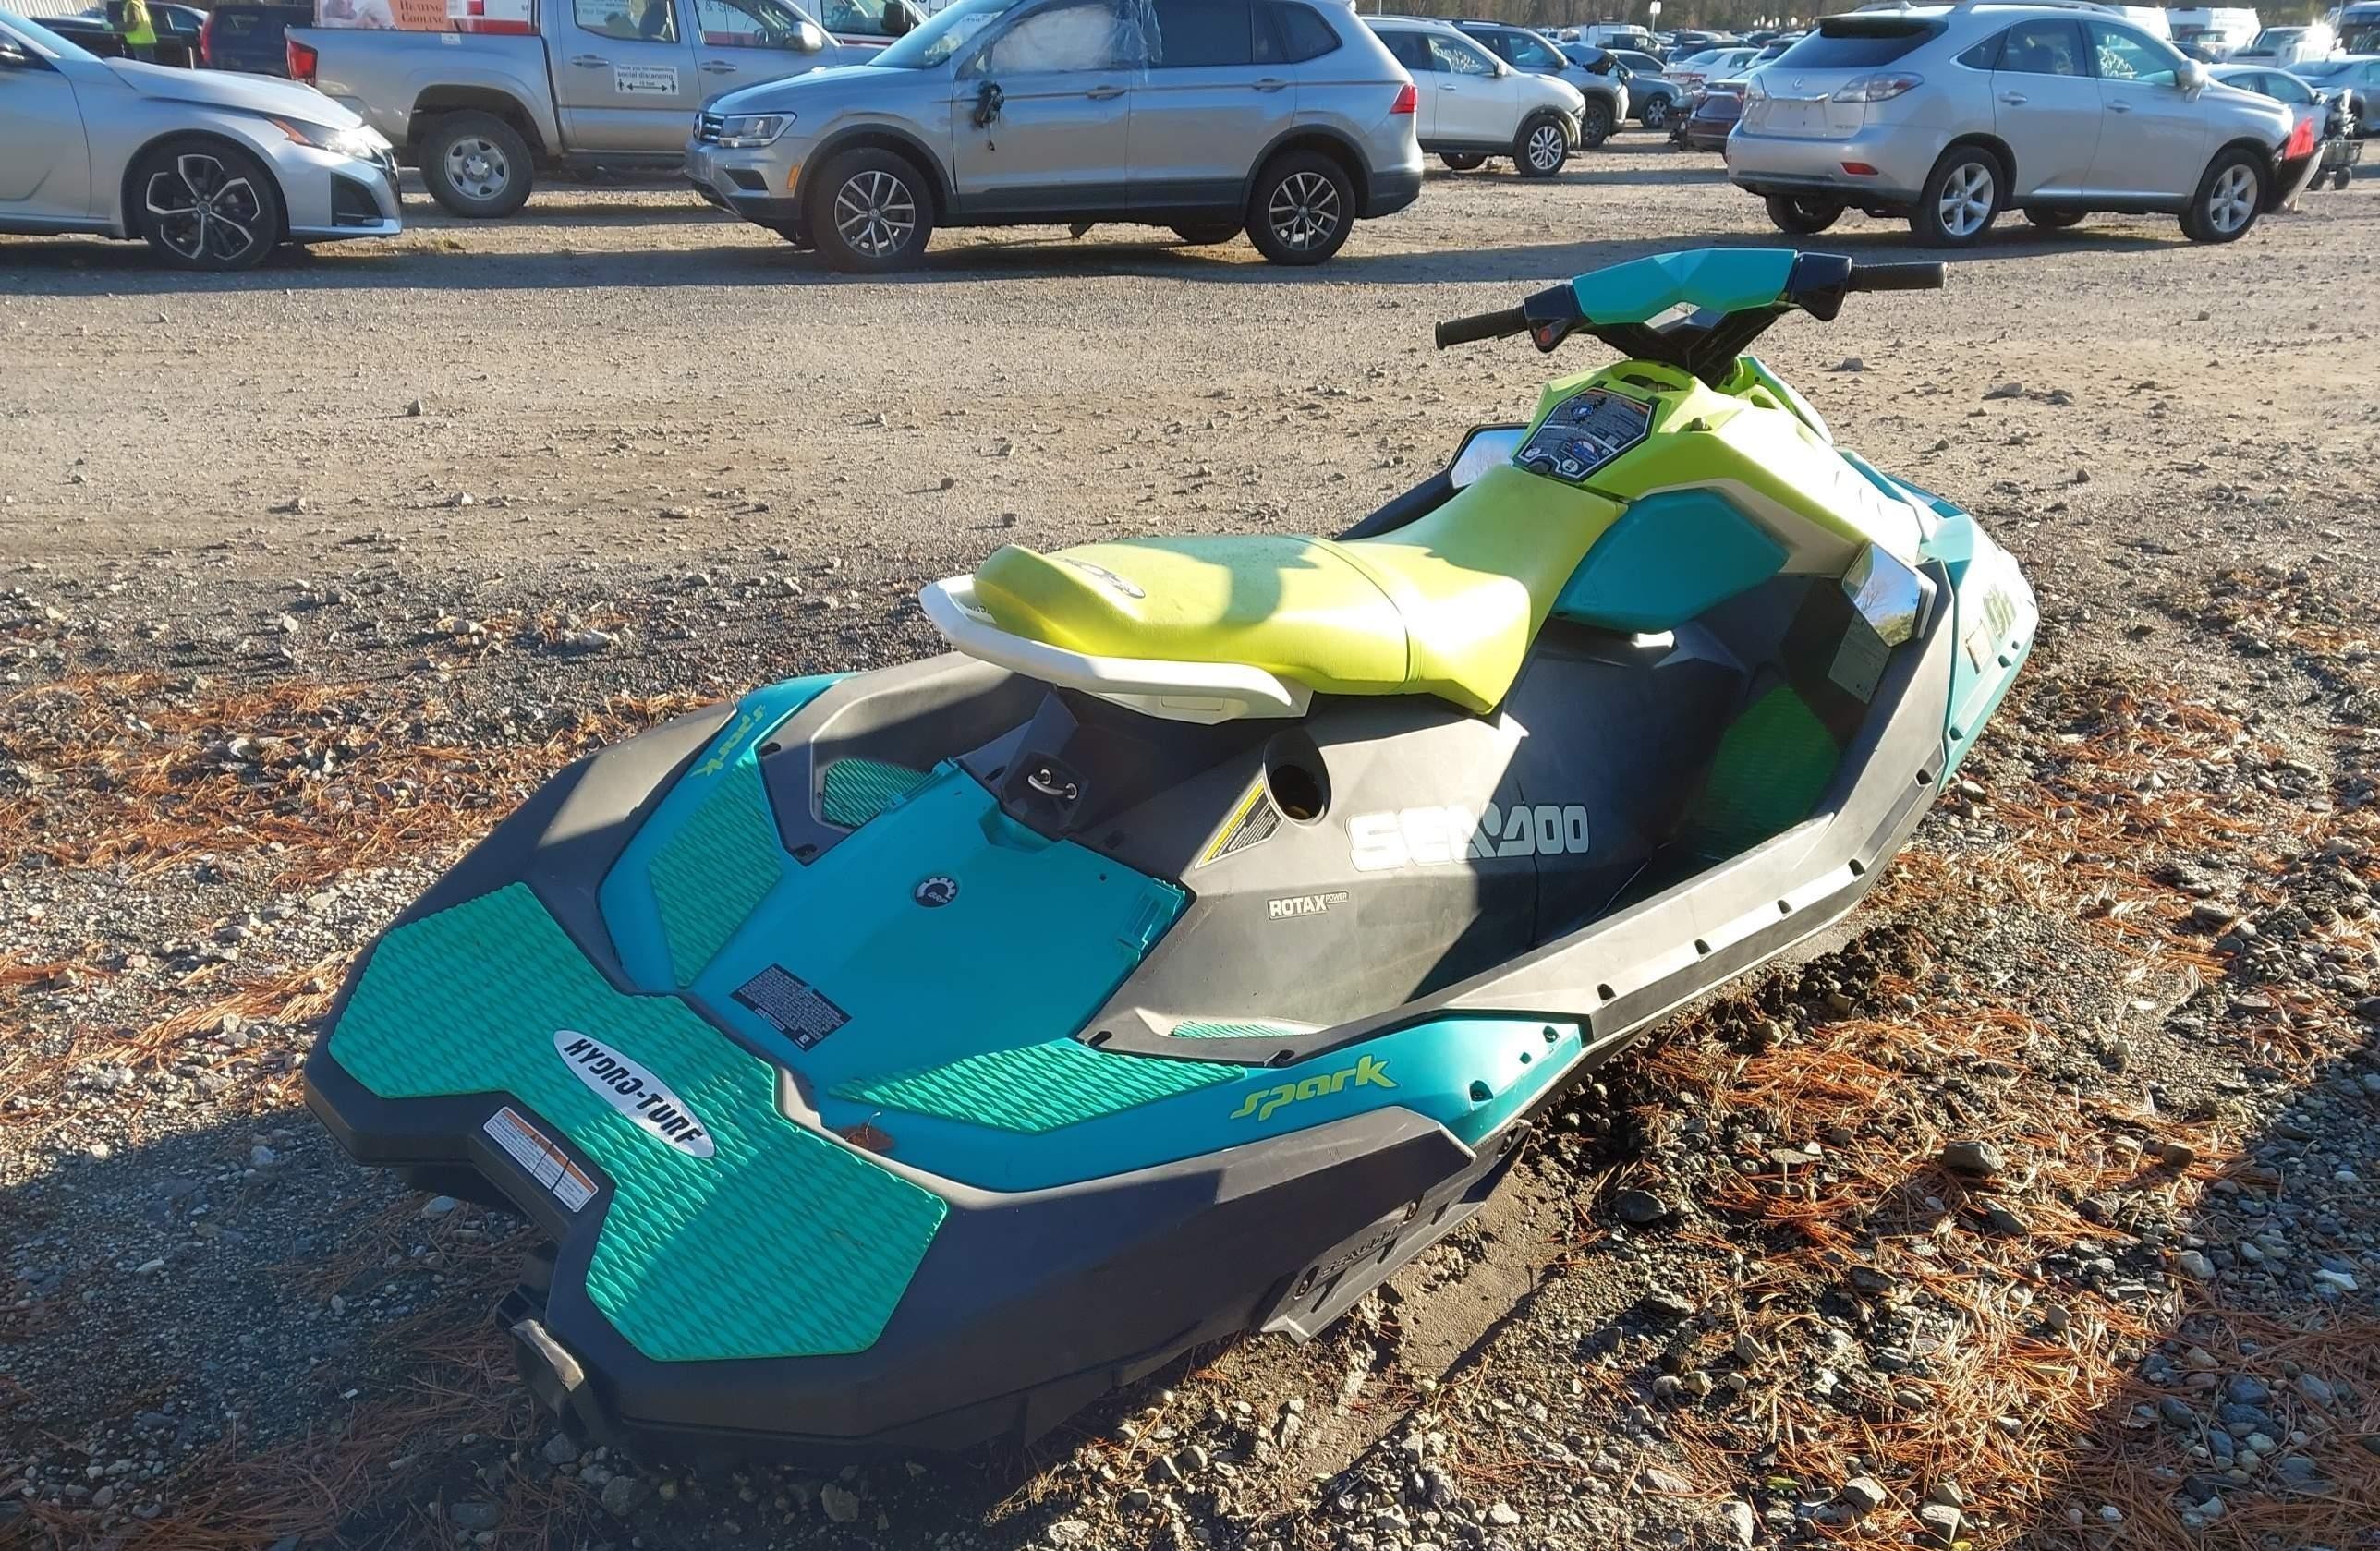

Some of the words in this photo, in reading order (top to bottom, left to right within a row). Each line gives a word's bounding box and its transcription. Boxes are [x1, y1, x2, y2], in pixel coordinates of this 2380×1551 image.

[639, 72, 674, 80] distancing
[1269, 894, 1327, 917] ROTAX
[1325, 892, 1347, 903] POWER
[563, 1038, 703, 1143] HYDRO-TURF
[1230, 1055, 1398, 1121] spark
